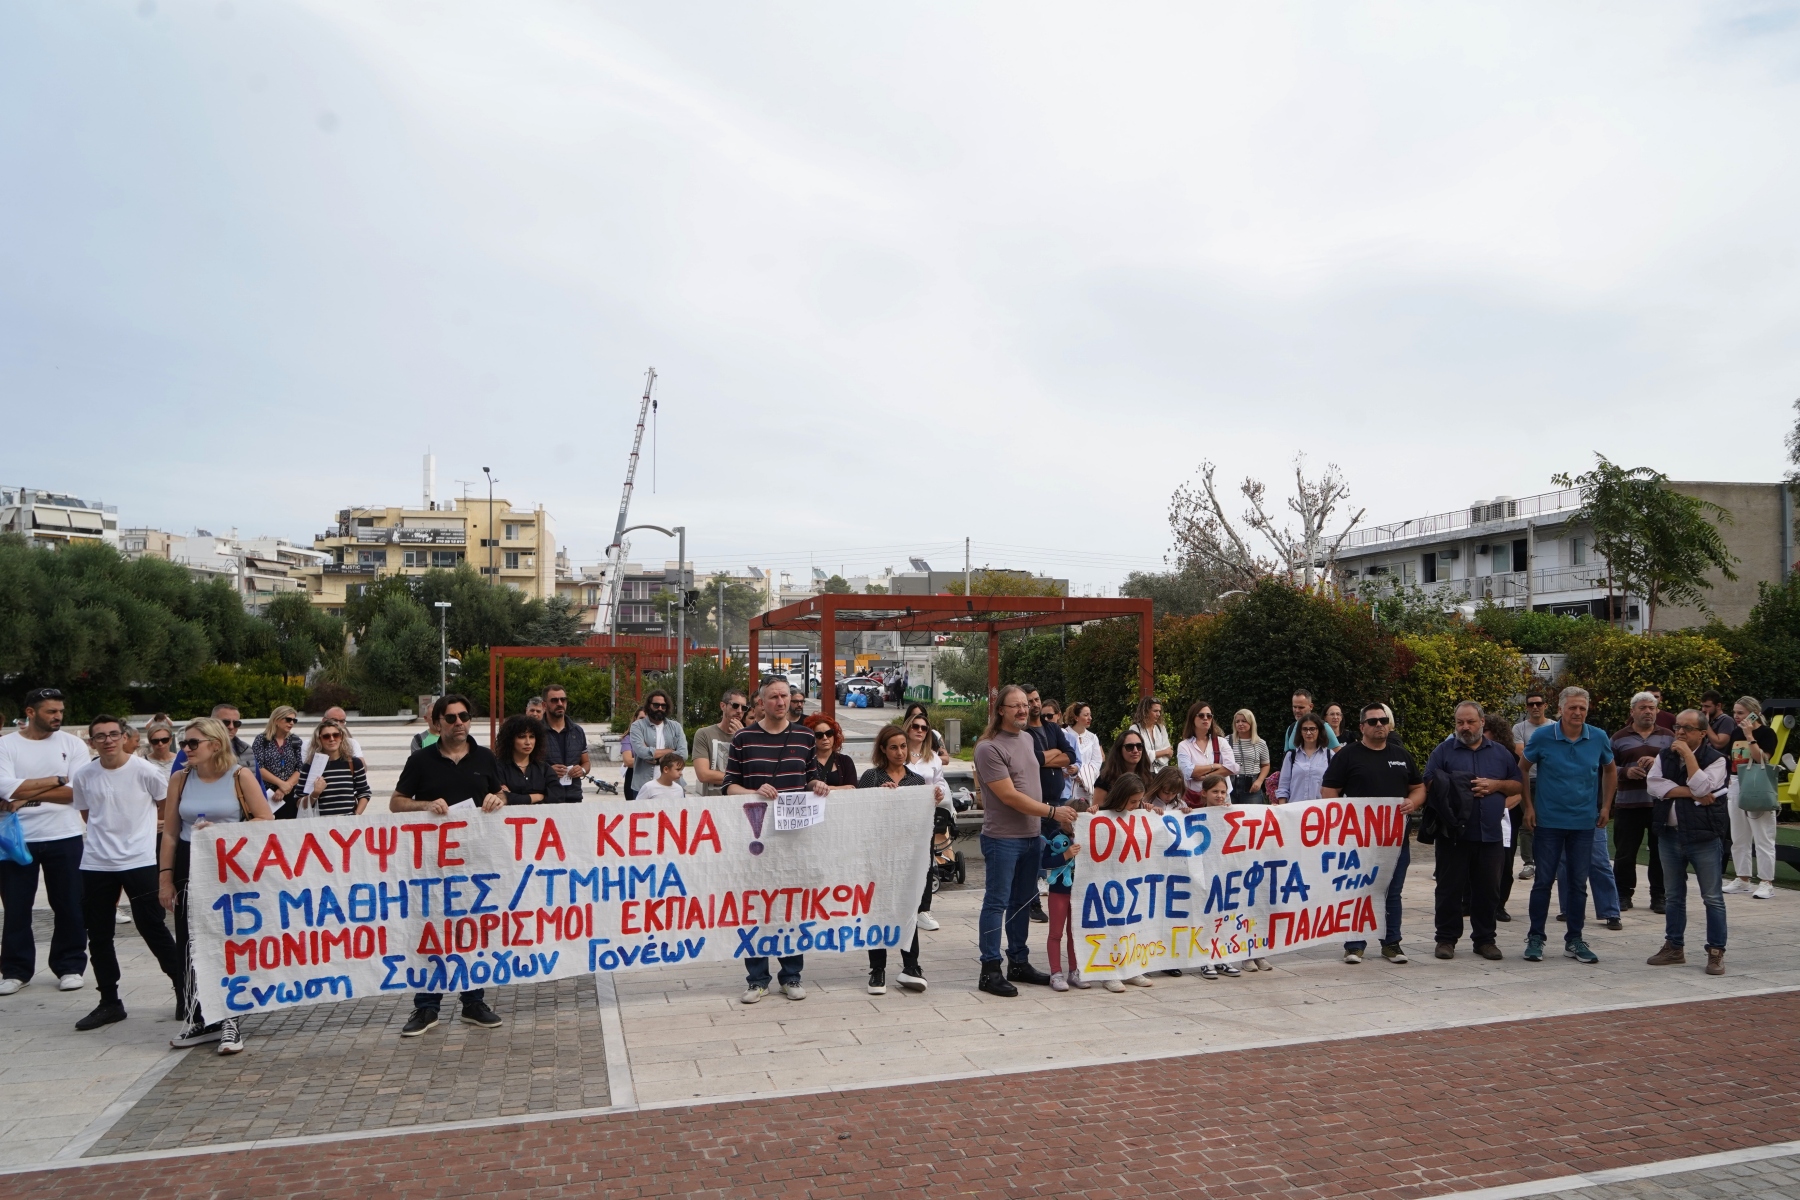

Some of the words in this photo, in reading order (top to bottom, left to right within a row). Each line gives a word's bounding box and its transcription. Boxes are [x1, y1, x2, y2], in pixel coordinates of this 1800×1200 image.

[777, 805, 819, 817] ΕΙΜΑΣΤΕ
[778, 794, 806, 805] ΔΕΝ
[778, 817, 814, 830] ΑΡΙΘΜΟΙ
[216, 821, 468, 883] ΚΑΛΥΨΤΕ
[504, 817, 566, 861] ΤΑ
[597, 809, 722, 857] ΚΕΝΑ
[1089, 815, 1153, 863] ΟΧΙ
[1163, 813, 1212, 857] 25
[1222, 808, 1284, 855] ΣΤΑ
[1301, 802, 1404, 848] ΘΡΑΝΙΑ
[1321, 849, 1361, 874] ΓΙΑ
[1332, 866, 1379, 892] ΤΗΝ
[213, 891, 263, 936] 15
[1081, 873, 1192, 928] ΔΩΣΤΕ
[1204, 860, 1310, 914] ΛΕΦΤΑ
[225, 925, 387, 975] ΜΟΝΙΜΟΙ
[416, 903, 593, 956] ΔΙΟΡΙΣΜΟΙ
[621, 882, 875, 934] ΕΚΠΑΙΔΕΥΤΙΚΩΝ
[1268, 895, 1378, 950] ΠΑΙΔΕΙΑ
[221, 975, 353, 1012] Ένωση
[380, 950, 560, 991] Συλλόγων
[588, 934, 706, 972] Γονέων
[734, 917, 901, 959] Χαϊδαρίου
